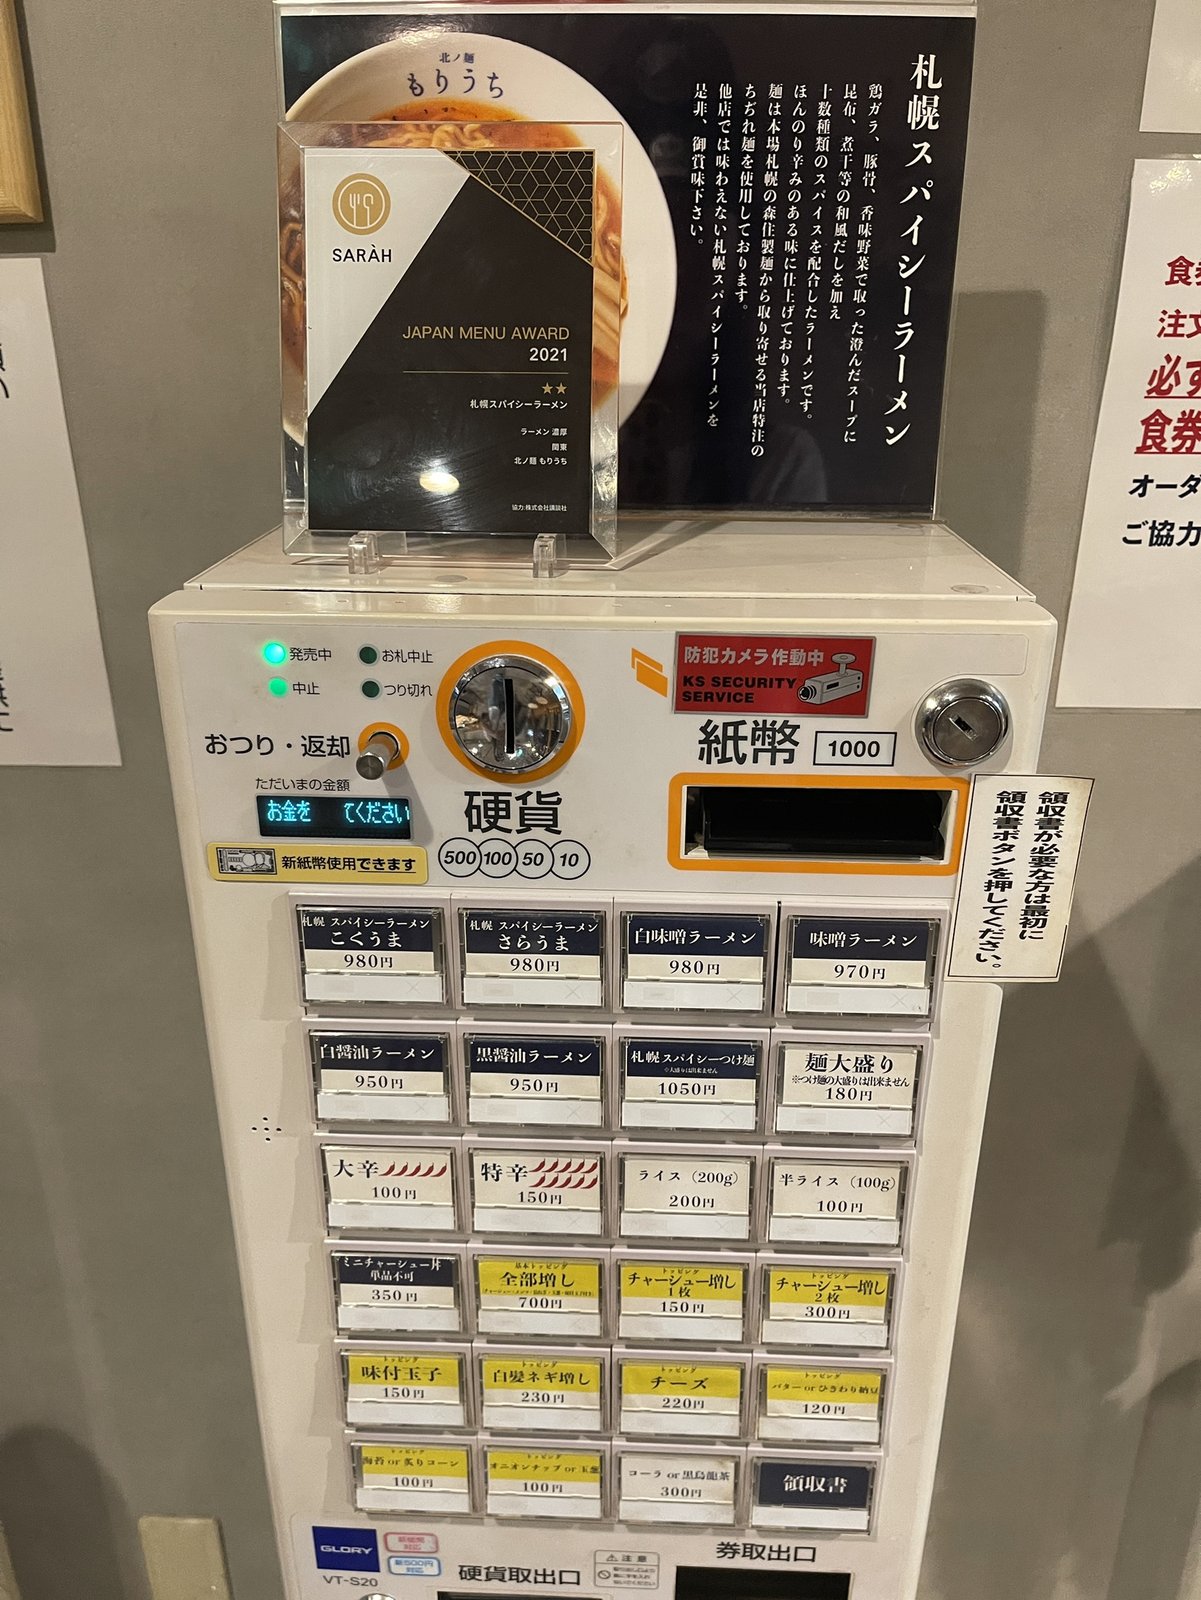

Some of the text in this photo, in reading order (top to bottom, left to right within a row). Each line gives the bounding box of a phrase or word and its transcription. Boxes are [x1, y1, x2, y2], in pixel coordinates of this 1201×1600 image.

[438, 52, 475, 64] 北ノ麺
[407, 68, 504, 99] もりうち
[690, 83, 708, 245] 是非、御賞味下さい。
[735, 83, 757, 310] ちぢれ麺を使用しております。
[829, 83, 858, 320] 昆布、煮干等の和風だしを加え
[777, 83, 808, 404] ほんのり辛みのある味に仕上げております。
[884, 53, 943, 446] 札幌スパイシーラーメン
[332, 244, 392, 263] SARÀH
[707, 83, 733, 427] 他店では味わえない札幌スパイシーラーメンを
[800, 83, 832, 420] 十数種類のスパイスを配合したラーメンです。
[1164, 255, 1201, 286] 食
[402, 326, 570, 340] JAPAN MENU AWARD
[529, 347, 568, 362] 2021
[470, 399, 568, 409] 札幌スパイシーラーメン
[520, 428, 550, 436] ラーメン
[552, 443, 568, 451] 関東
[539, 457, 568, 465] もりうち
[1122, 520, 1201, 547] ご協力
[289, 647, 332, 662] 発売中
[381, 649, 434, 664] お札中止
[684, 646, 824, 667] 防犯カメラ作動中
[292, 681, 320, 695] 中止
[682, 676, 797, 689] KS SECURITY
[384, 684, 433, 697] つり切れ
[682, 691, 754, 703] SERVICE
[204, 734, 350, 759] おつり・返却
[698, 719, 801, 766] 紙幣
[828, 740, 881, 757] 1000
[255, 777, 350, 792] ただいまの金額
[267, 800, 312, 822] お金を
[464, 790, 562, 835] 硬貨
[281, 856, 416, 871] 新紙幣使用できます
[443, 851, 579, 867] 500 100 50 10
[1019, 791, 1070, 940] 領収書が必要な方は最初に
[976, 790, 1028, 968] 領収書ボタンを押してください。
[302, 915, 430, 930] 札幌 スパイシーラーメン
[469, 919, 599, 933] 札幌 スパイシーラーメン
[330, 931, 403, 948] こくうま
[498, 934, 570, 951] さらうま
[634, 928, 757, 945] 白味噌ラーメン
[809, 931, 918, 948] 味噌ラーメン
[343, 953, 393, 969] 980円
[510, 957, 560, 973] 980円
[669, 959, 720, 975] 980円
[833, 964, 886, 980] 970円
[320, 1043, 435, 1060] 白醤油ラーメン
[476, 1046, 593, 1064] 黒醤油ラーメン
[804, 1052, 894, 1074] 麺大盛り
[355, 1074, 404, 1089] 950円
[509, 1077, 559, 1093] 950円
[658, 1081, 716, 1096] 1050円
[791, 1074, 911, 1088] ※つけ麺の大盛りは出来ません
[825, 1087, 873, 1102] 180円
[333, 1159, 379, 1179] 大辛
[480, 1162, 528, 1183] 特辛
[371, 1186, 417, 1200] 100円
[517, 1190, 562, 1205] 150円
[669, 1194, 715, 1209] 200円
[817, 1199, 864, 1213] 100円
[370, 1270, 415, 1283] 単品不可
[500, 1271, 575, 1288] 全部増し
[628, 1272, 737, 1290] チャーシュー増し
[668, 1287, 691, 1298] 1枚
[776, 1277, 886, 1296] チャーシュー増し
[371, 1289, 418, 1302] 350円
[518, 1296, 563, 1310] 700円
[814, 1292, 840, 1304] 2枚
[660, 1301, 704, 1314] 150円
[805, 1306, 851, 1320] 300円
[361, 1365, 442, 1382] 味付玉子
[493, 1369, 591, 1386] 白髪ネギ増し
[650, 1375, 708, 1390] チーズ
[383, 1387, 425, 1400] 150円
[521, 1391, 565, 1404] 230円
[662, 1397, 705, 1410] 220円
[802, 1403, 846, 1416] 120円
[394, 1476, 434, 1488] 100円
[628, 1470, 662, 1478] コーラ
[667, 1471, 681, 1479] or
[522, 1481, 563, 1494] 100円
[783, 1474, 848, 1494] 領収書
[660, 1486, 702, 1498] 300円
[320, 1544, 373, 1555] GLORY
[716, 1541, 817, 1563] 券取出口
[322, 1575, 379, 1588] VT-S20
[458, 1564, 581, 1586] 硬貨取出口
